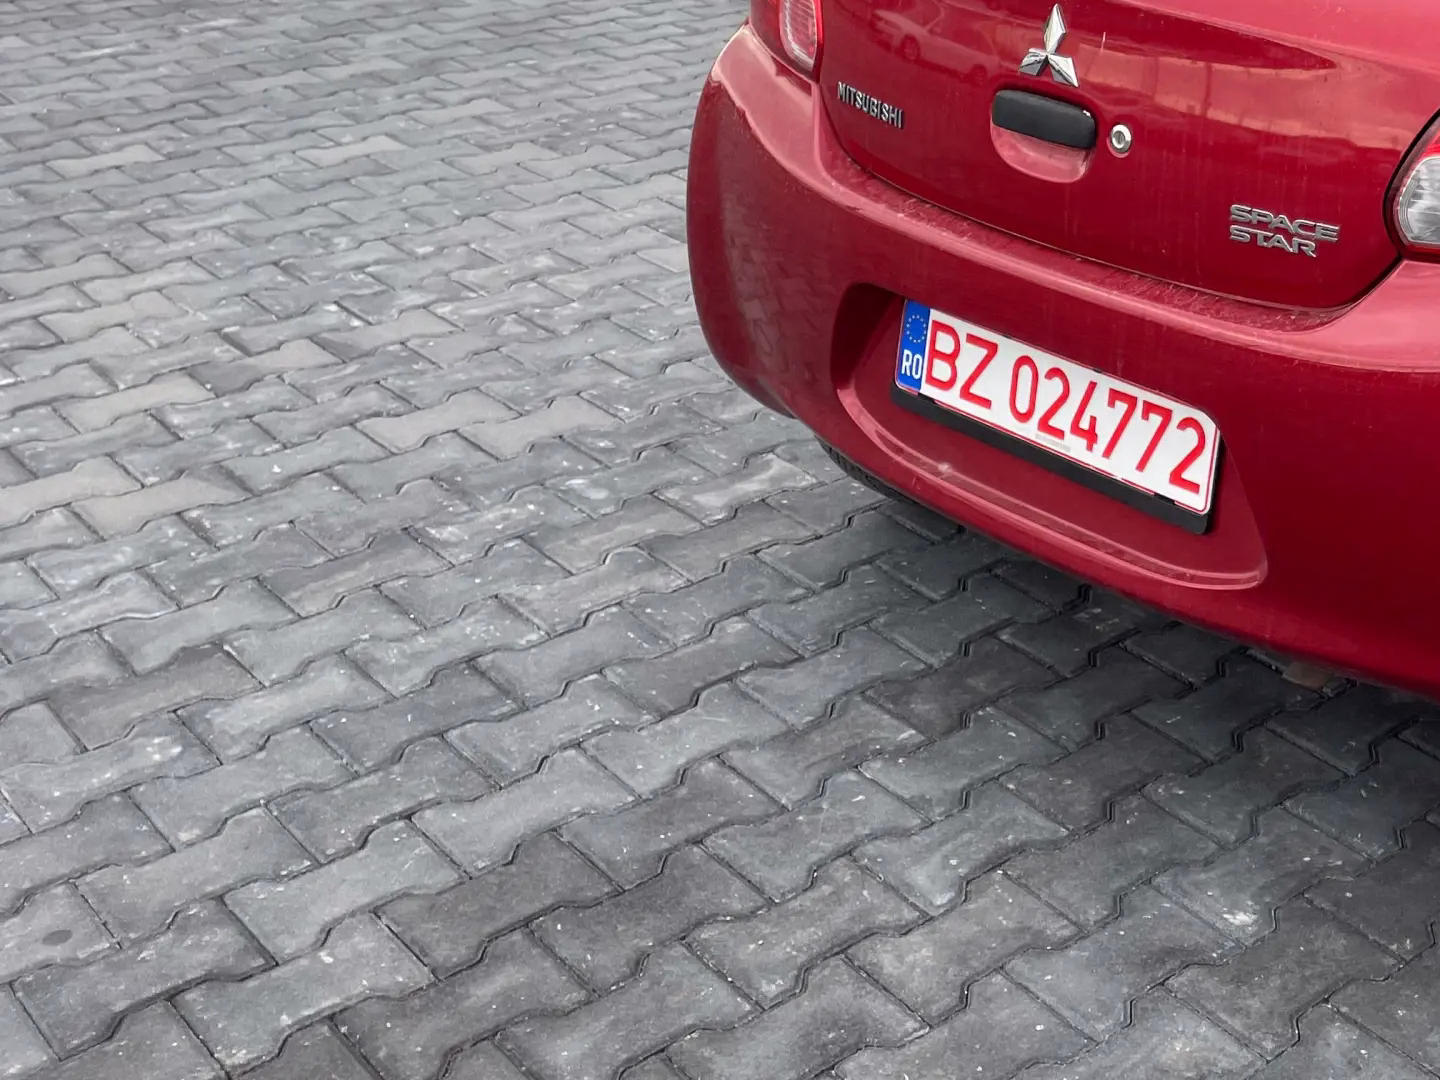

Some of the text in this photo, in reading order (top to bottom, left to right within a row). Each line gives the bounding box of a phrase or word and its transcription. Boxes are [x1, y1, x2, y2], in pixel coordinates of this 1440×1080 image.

[837, 81, 904, 129] MITSUBISHI
[1229, 225, 1317, 257] STAR
[1230, 204, 1340, 242] SPACE
[901, 349, 923, 381] RO
[925, 320, 1206, 494] BZ 024772
